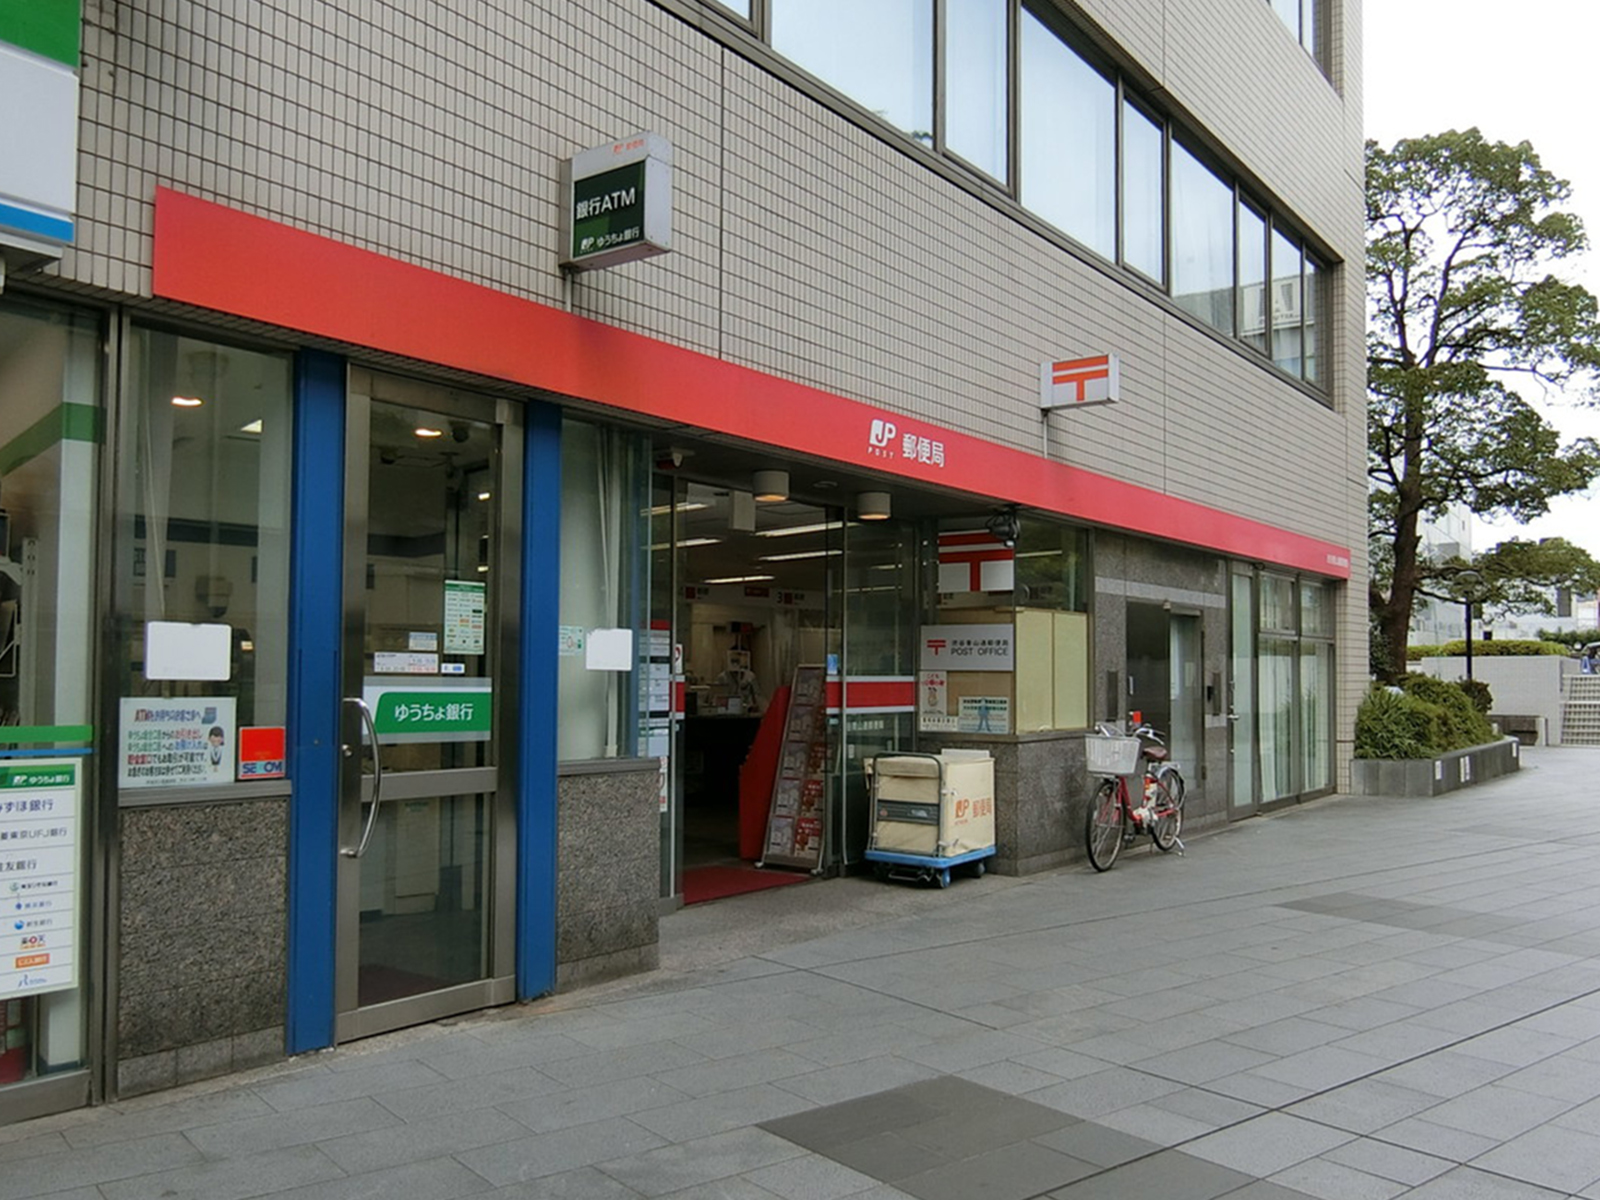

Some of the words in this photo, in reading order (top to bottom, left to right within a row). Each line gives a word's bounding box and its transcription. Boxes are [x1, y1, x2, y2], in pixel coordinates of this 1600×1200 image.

[575, 187, 635, 220] 銀行ATM
[596, 226, 640, 248] ゆうちょ銀行
[869, 419, 897, 448] JP
[902, 432, 945, 468] 郵便局
[950, 647, 973, 656] POST
[977, 647, 1009, 656] OFFICE
[394, 703, 473, 721] ゆうちょ銀行
[29, 774, 70, 785] ゆうちょ銀行
